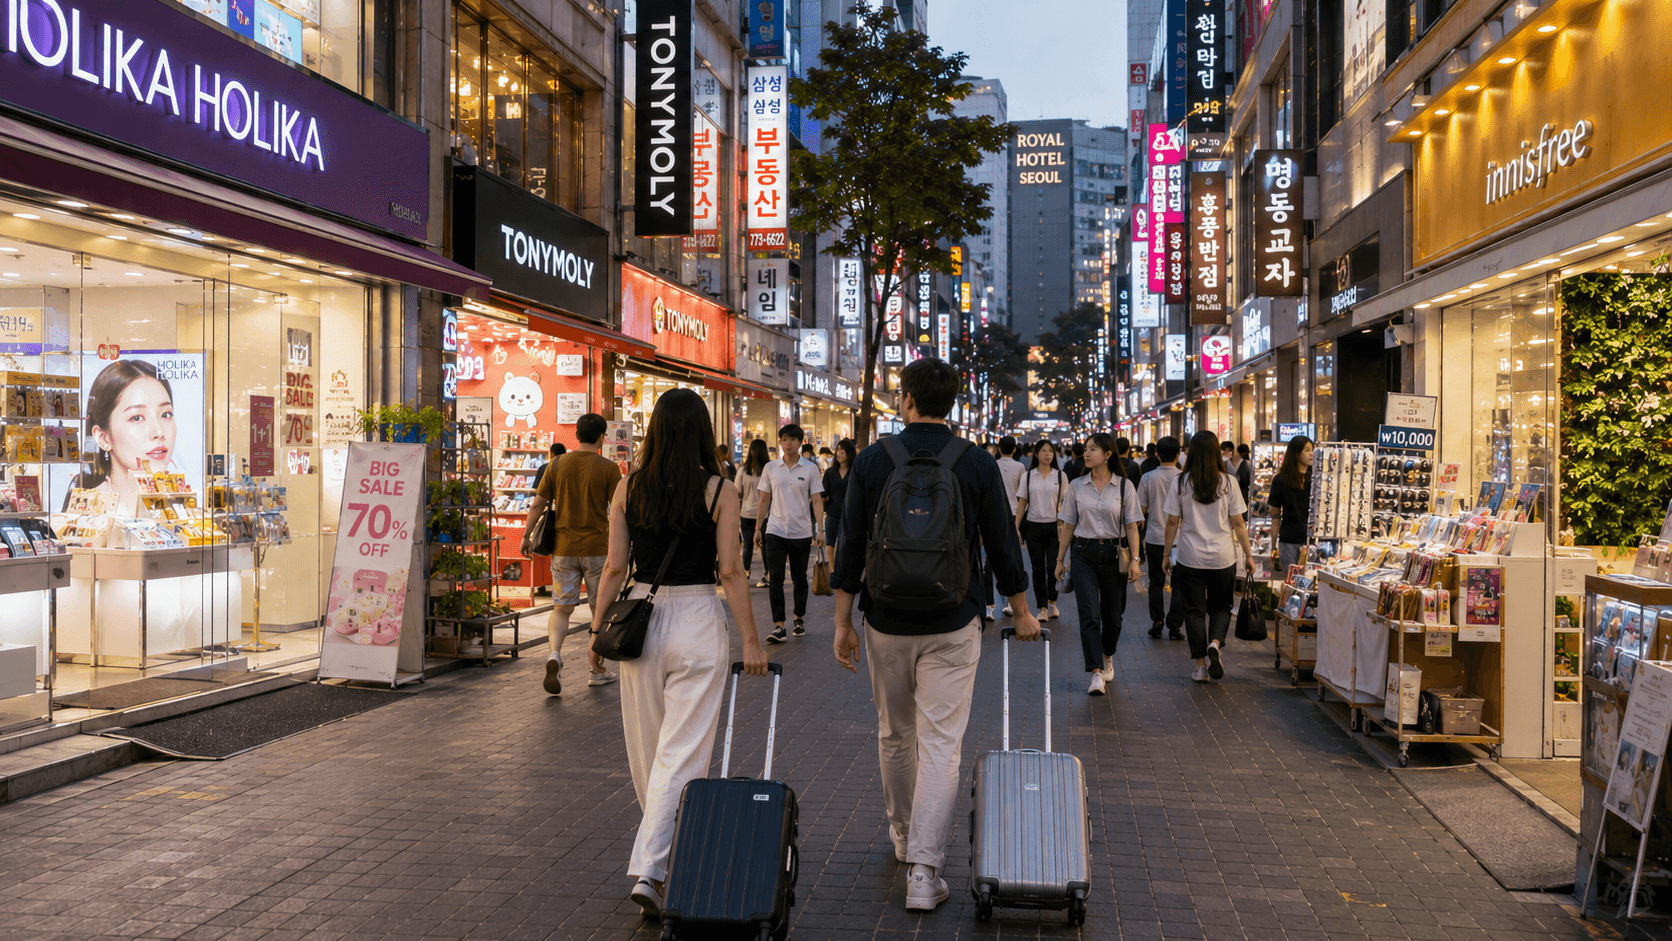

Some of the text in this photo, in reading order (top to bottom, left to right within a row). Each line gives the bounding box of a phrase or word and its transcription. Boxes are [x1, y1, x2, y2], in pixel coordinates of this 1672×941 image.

[752, 74, 782, 93] 삼성
[194, 64, 325, 172] HOLIKA
[650, 15, 676, 217] TONYMOLY
[1017, 132, 1065, 148] ROYAL
[1016, 151, 1066, 167] HOTEL
[1486, 119, 1587, 205] innisfree
[754, 127, 781, 218] 부동산
[1019, 170, 1063, 185] SEOUL
[1264, 157, 1296, 288] 명동교자
[501, 224, 595, 289] TONYMOLY
[665, 307, 710, 342] TONYMOLY
[157, 360, 197, 370] HOLIKA
[286, 388, 314, 409] SALE
[369, 460, 400, 478] BIG
[359, 478, 405, 497] SALE
[347, 502, 408, 540] 70%
[359, 541, 390, 558] OFF
